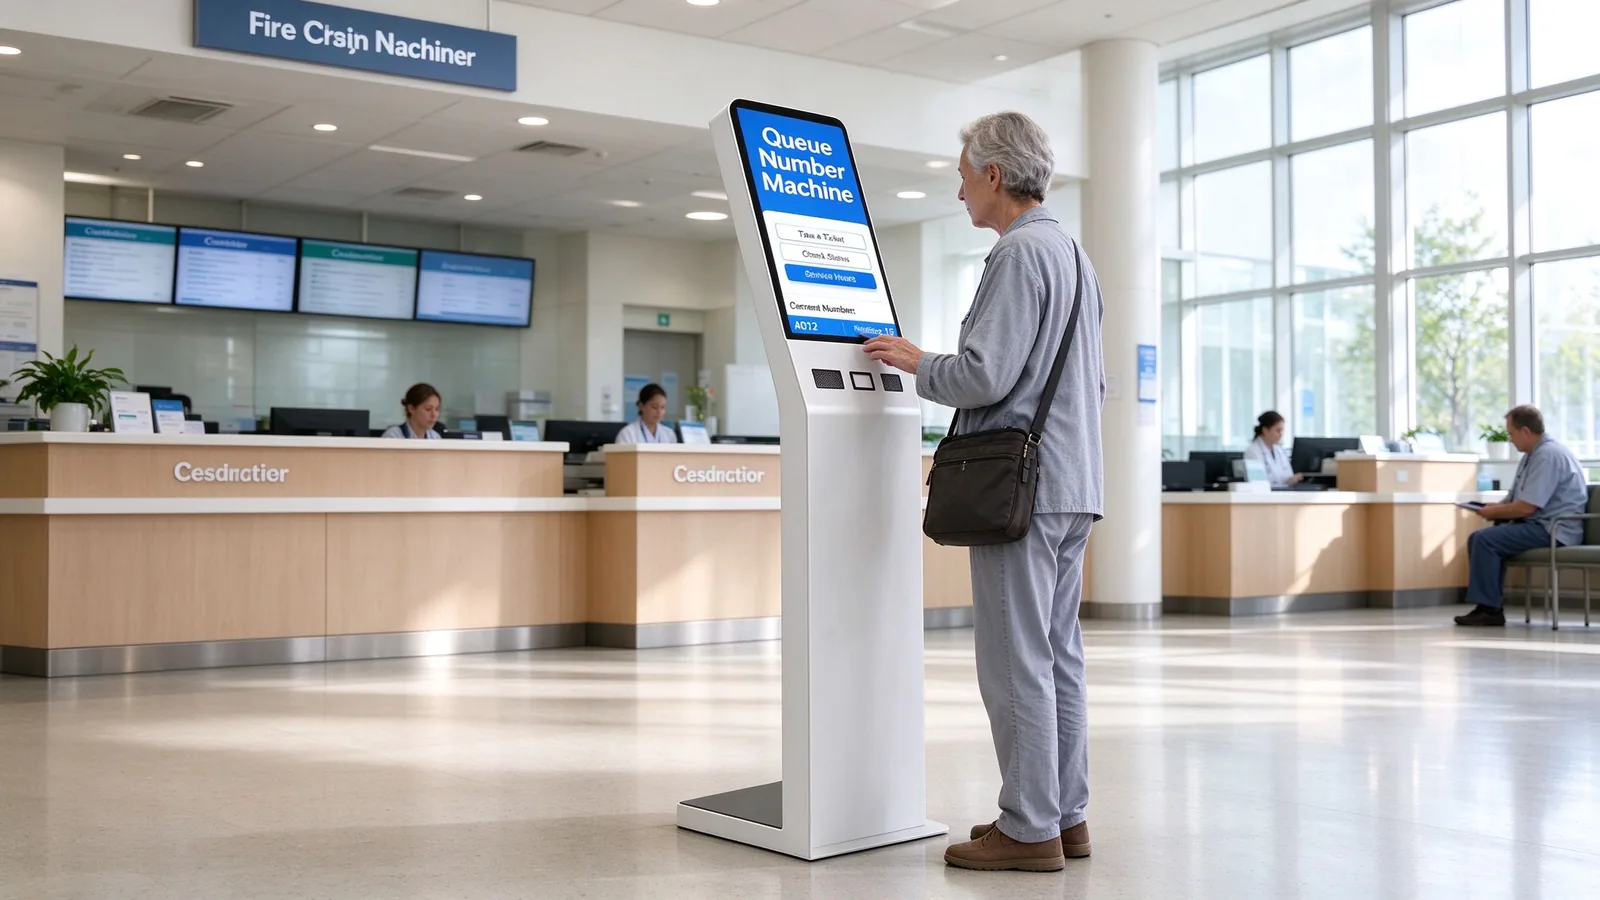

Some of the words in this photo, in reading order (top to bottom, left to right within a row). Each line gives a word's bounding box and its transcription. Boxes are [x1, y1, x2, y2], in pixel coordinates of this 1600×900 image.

[249, 11, 296, 41] Fire
[375, 30, 476, 67] Nachiner
[761, 127, 833, 156] Queue
[758, 147, 845, 180] Number
[761, 171, 854, 203] Machine
[794, 320, 818, 331] A012
